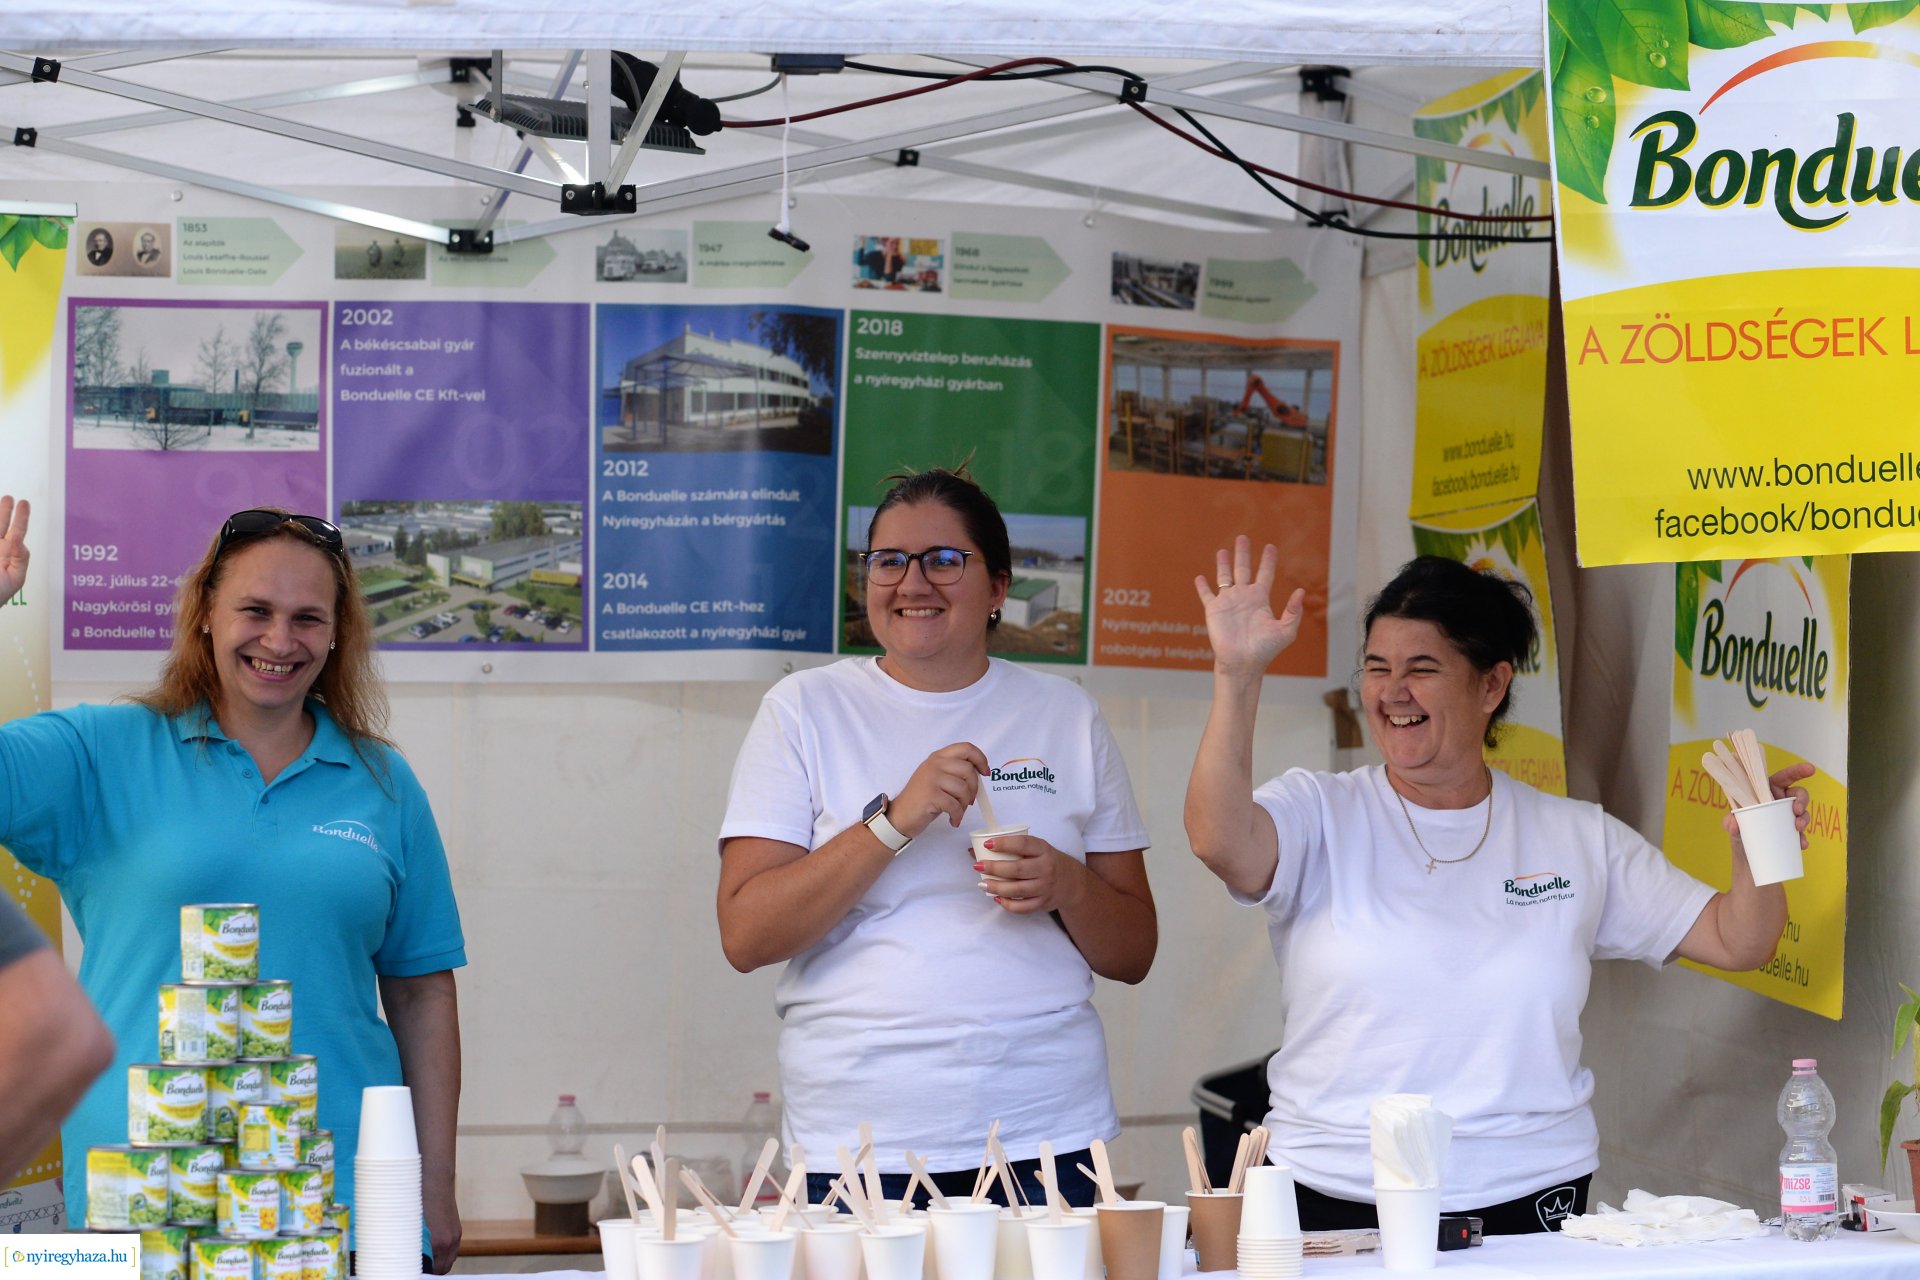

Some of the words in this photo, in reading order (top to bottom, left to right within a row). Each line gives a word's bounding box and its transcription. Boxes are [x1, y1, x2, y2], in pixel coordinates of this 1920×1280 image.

[183, 223, 208, 233] 1853
[341, 309, 393, 326] 2002
[857, 318, 904, 336] 2018
[1578, 325, 1609, 365] A
[1620, 307, 1888, 365] ZÖLDSÉGEK
[341, 340, 351, 350] A
[354, 338, 441, 351] békéscsabai
[444, 339, 475, 353] gyár
[855, 347, 958, 367] Szennyvíztelep
[962, 352, 1032, 368] beruházás
[341, 364, 402, 376] fuzionált
[405, 367, 414, 376] a
[854, 374, 863, 384] a
[947, 376, 1003, 391] gyárban
[341, 389, 412, 401] Bonduelle
[415, 390, 435, 401] CE
[439, 389, 486, 401] Kft-vel
[603, 460, 649, 477] 2012
[1687, 452, 1920, 491] www.bonduell
[603, 491, 613, 501] A
[616, 489, 687, 501] Bonduelle
[690, 488, 748, 501] számára
[751, 488, 800, 502] elindult
[603, 515, 698, 530] Nyíregyházán
[702, 517, 710, 526] a
[713, 514, 786, 529] bérgyártás
[1655, 499, 1920, 539] facebook/bondu
[72, 545, 118, 561] 1992
[72, 575, 107, 587] 1992.
[109, 574, 148, 589] július
[603, 573, 649, 590] 2014
[1103, 587, 1151, 607] 2022
[72, 600, 151, 616] Nagykőrösi
[603, 603, 613, 614] A
[616, 602, 687, 615] Bonduelle
[690, 602, 709, 613] CE
[713, 601, 765, 613] Kft-hez
[71, 628, 80, 638] a
[84, 625, 155, 638] Bonduelle
[603, 628, 687, 640] csatlakozott
[690, 630, 699, 639] a
[702, 626, 779, 641] nyíregyházi
[782, 628, 806, 641] gyár
[1701, 598, 1828, 711] Bonduelle
[991, 767, 1055, 783] Bonduelle
[1672, 767, 1684, 799] A
[1807, 800, 1842, 843] JAVA
[312, 824, 379, 853] Bonduelle
[1503, 877, 1570, 898] Bonduelle
